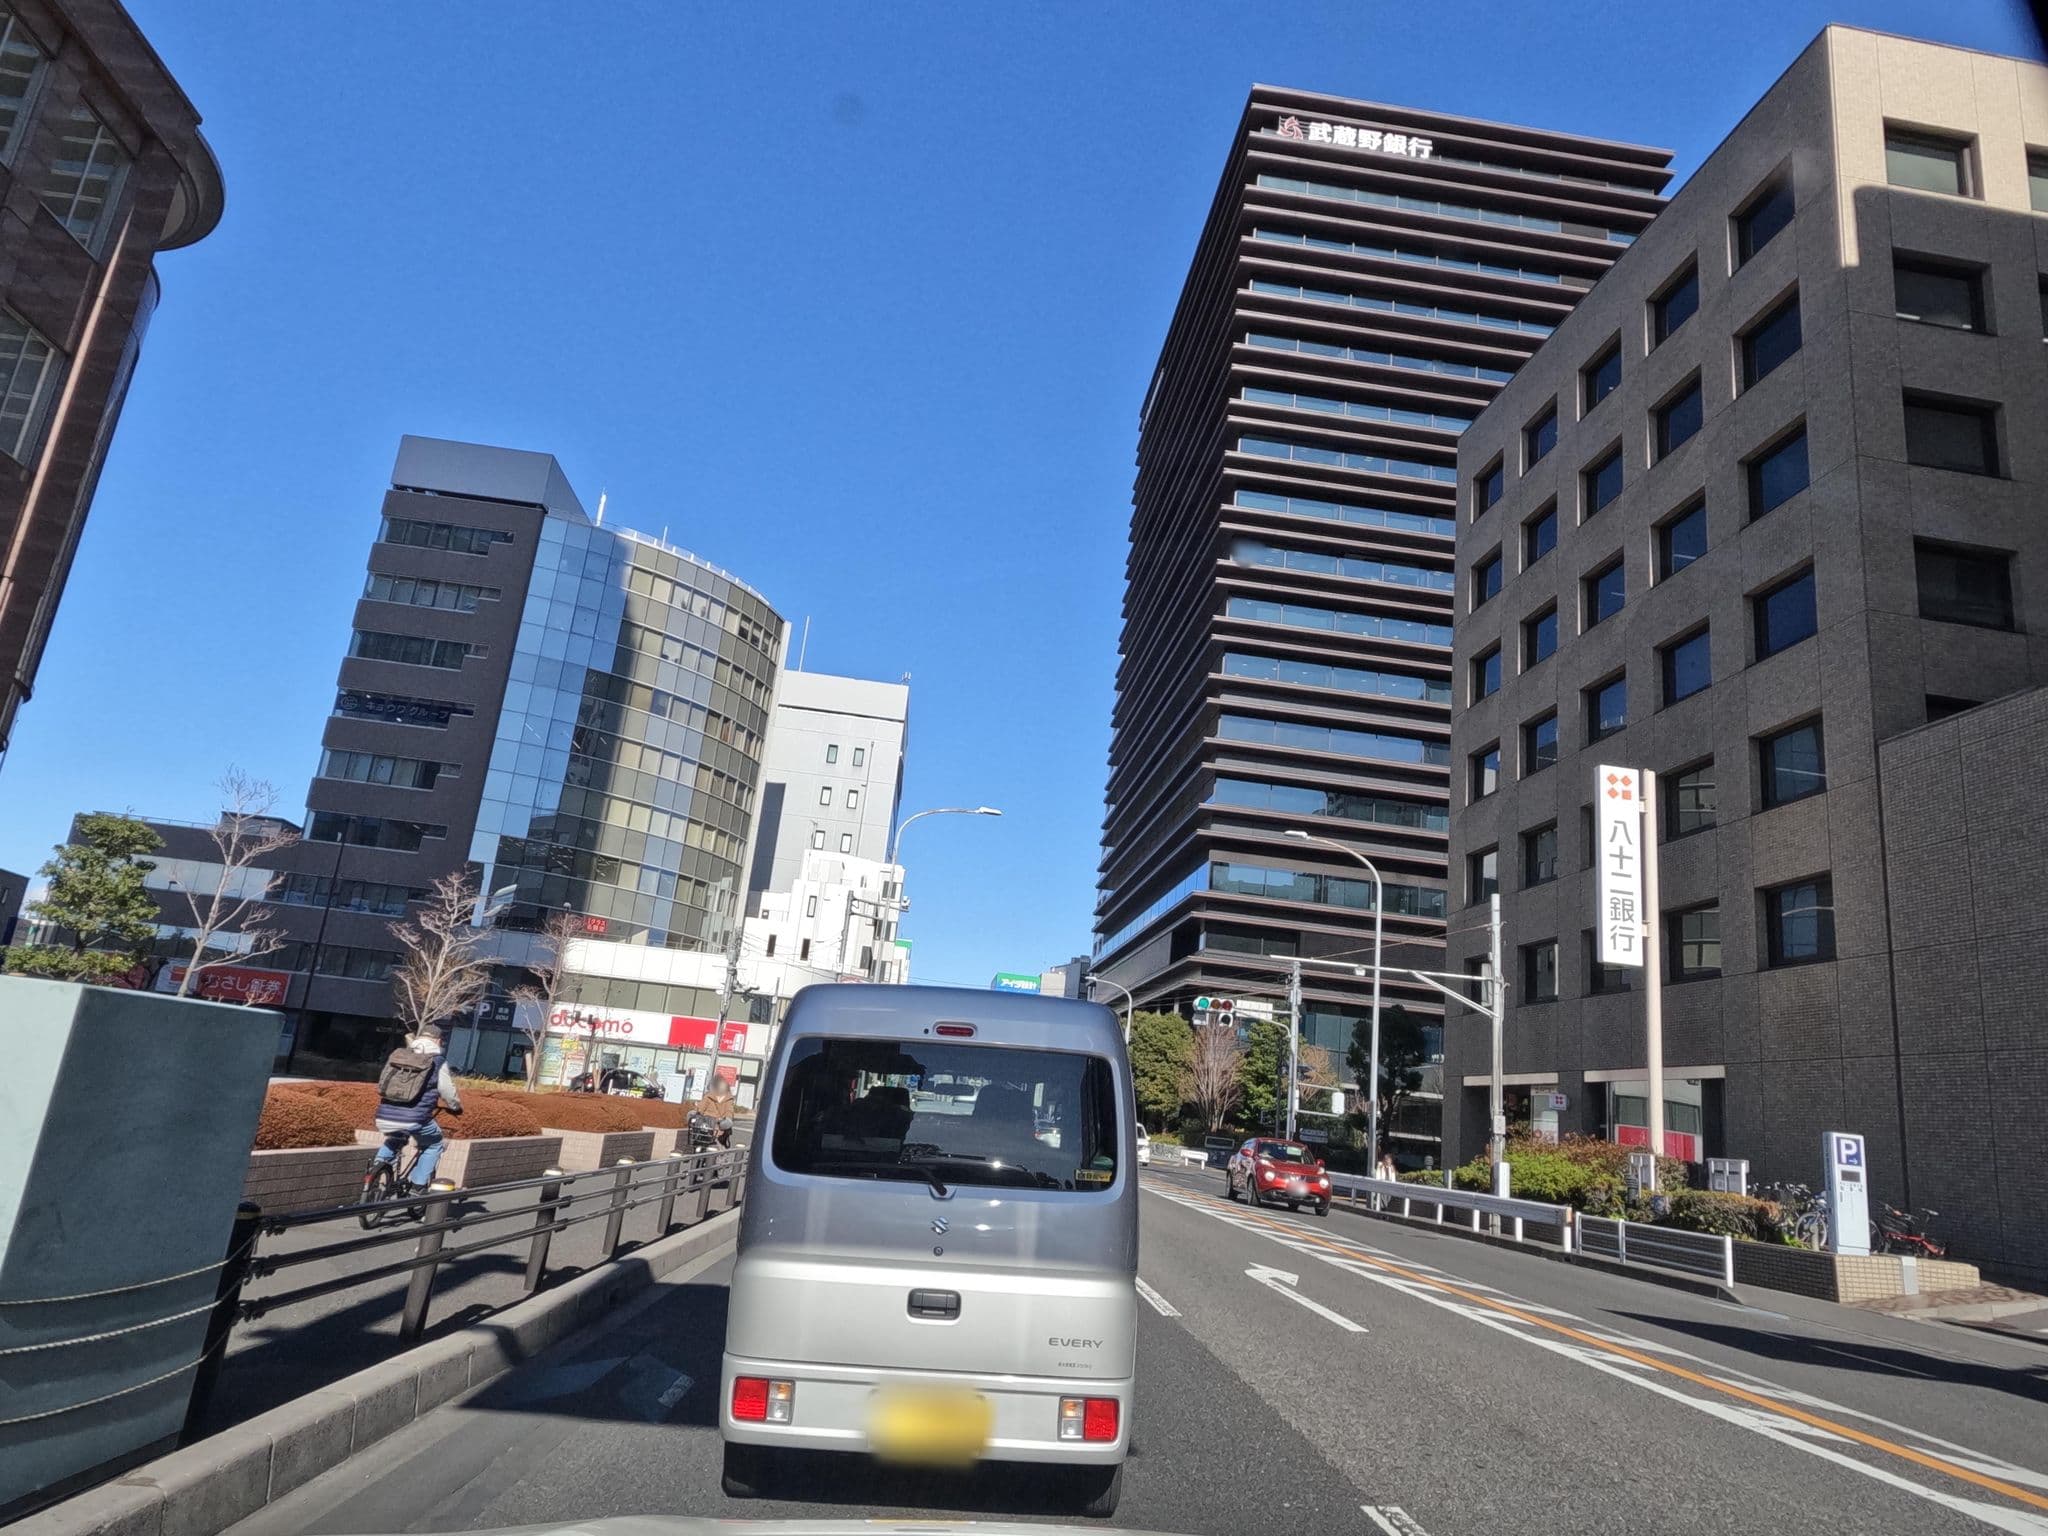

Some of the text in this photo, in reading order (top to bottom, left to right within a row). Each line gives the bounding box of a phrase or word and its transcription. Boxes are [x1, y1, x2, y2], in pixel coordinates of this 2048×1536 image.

[1308, 121, 1433, 158] 武蔵野銀行
[1609, 819, 1635, 952] 八十二銀行
[550, 1009, 633, 1034] docomo
[1840, 1138, 1858, 1164] P
[1048, 1337, 1104, 1349] EVERY
